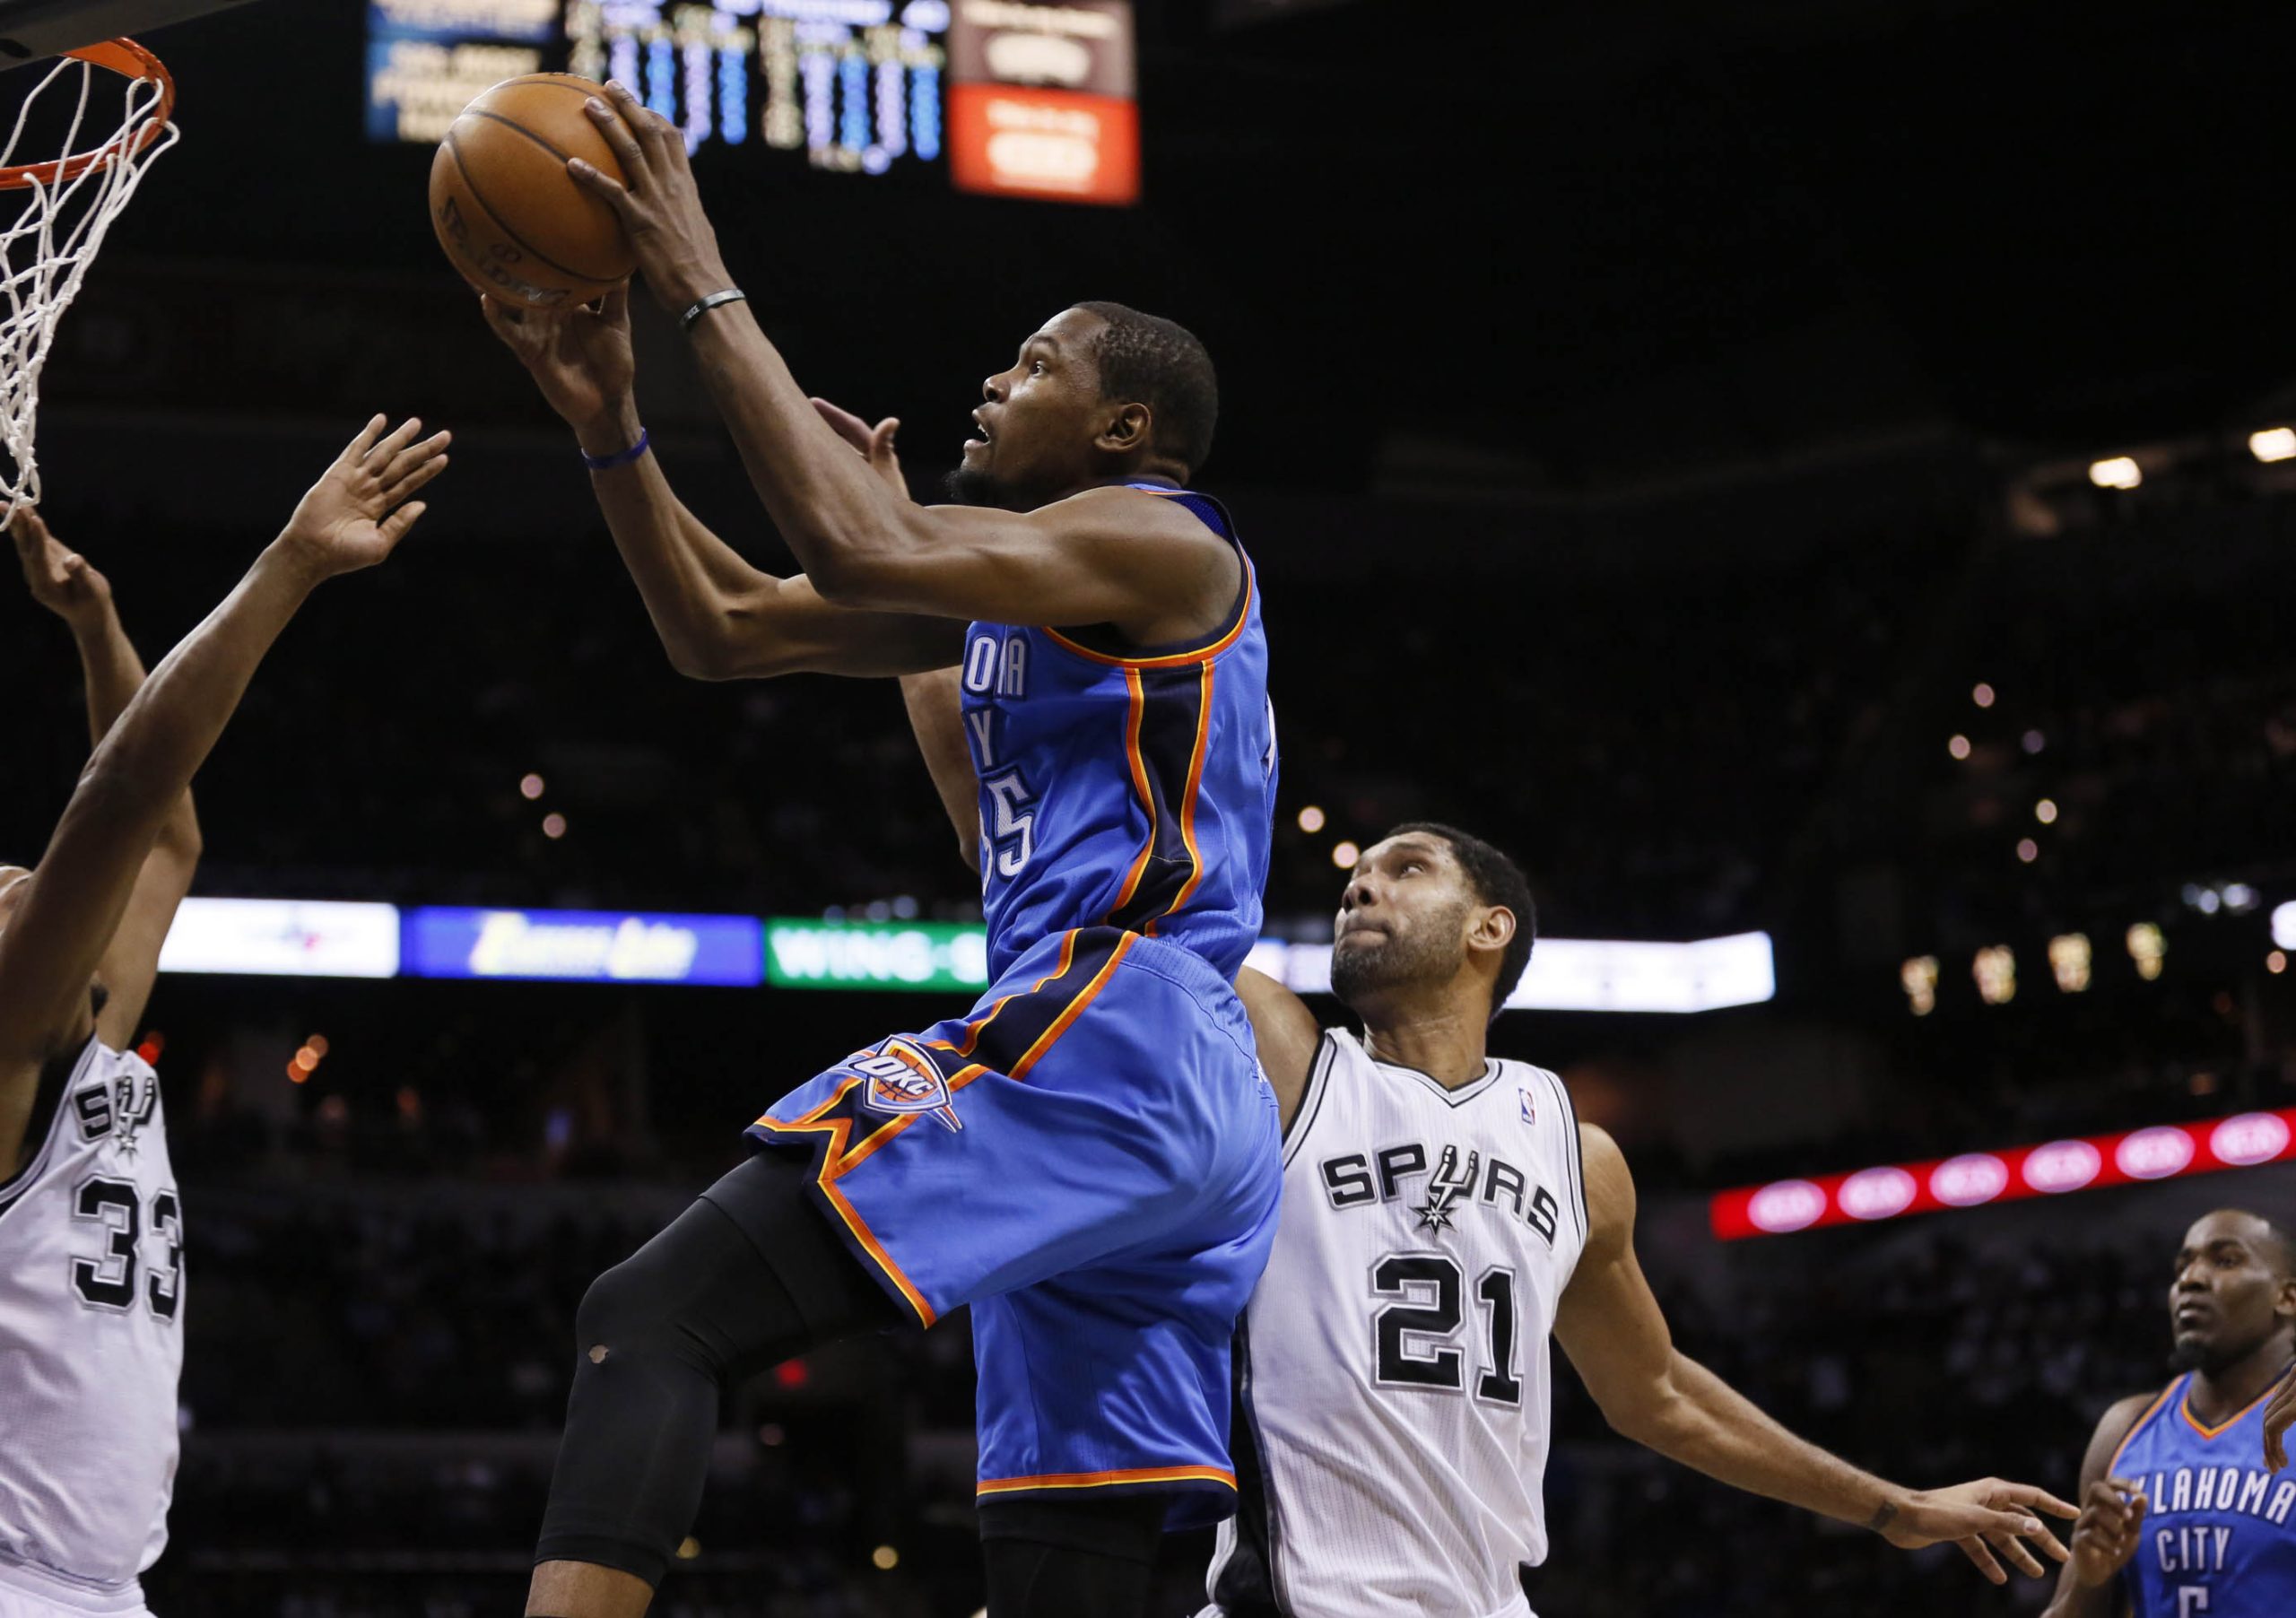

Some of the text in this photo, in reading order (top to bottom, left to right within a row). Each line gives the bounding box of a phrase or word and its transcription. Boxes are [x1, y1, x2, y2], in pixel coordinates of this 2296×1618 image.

[850, 1055, 935, 1097] OKC
[1321, 1143, 1560, 1249] SPURS
[71, 1174, 180, 1326] 33
[1369, 1251, 1523, 1407] 21
[2118, 1466, 2296, 1525] LAHOMA
[2155, 1526, 2231, 1573] CITY
